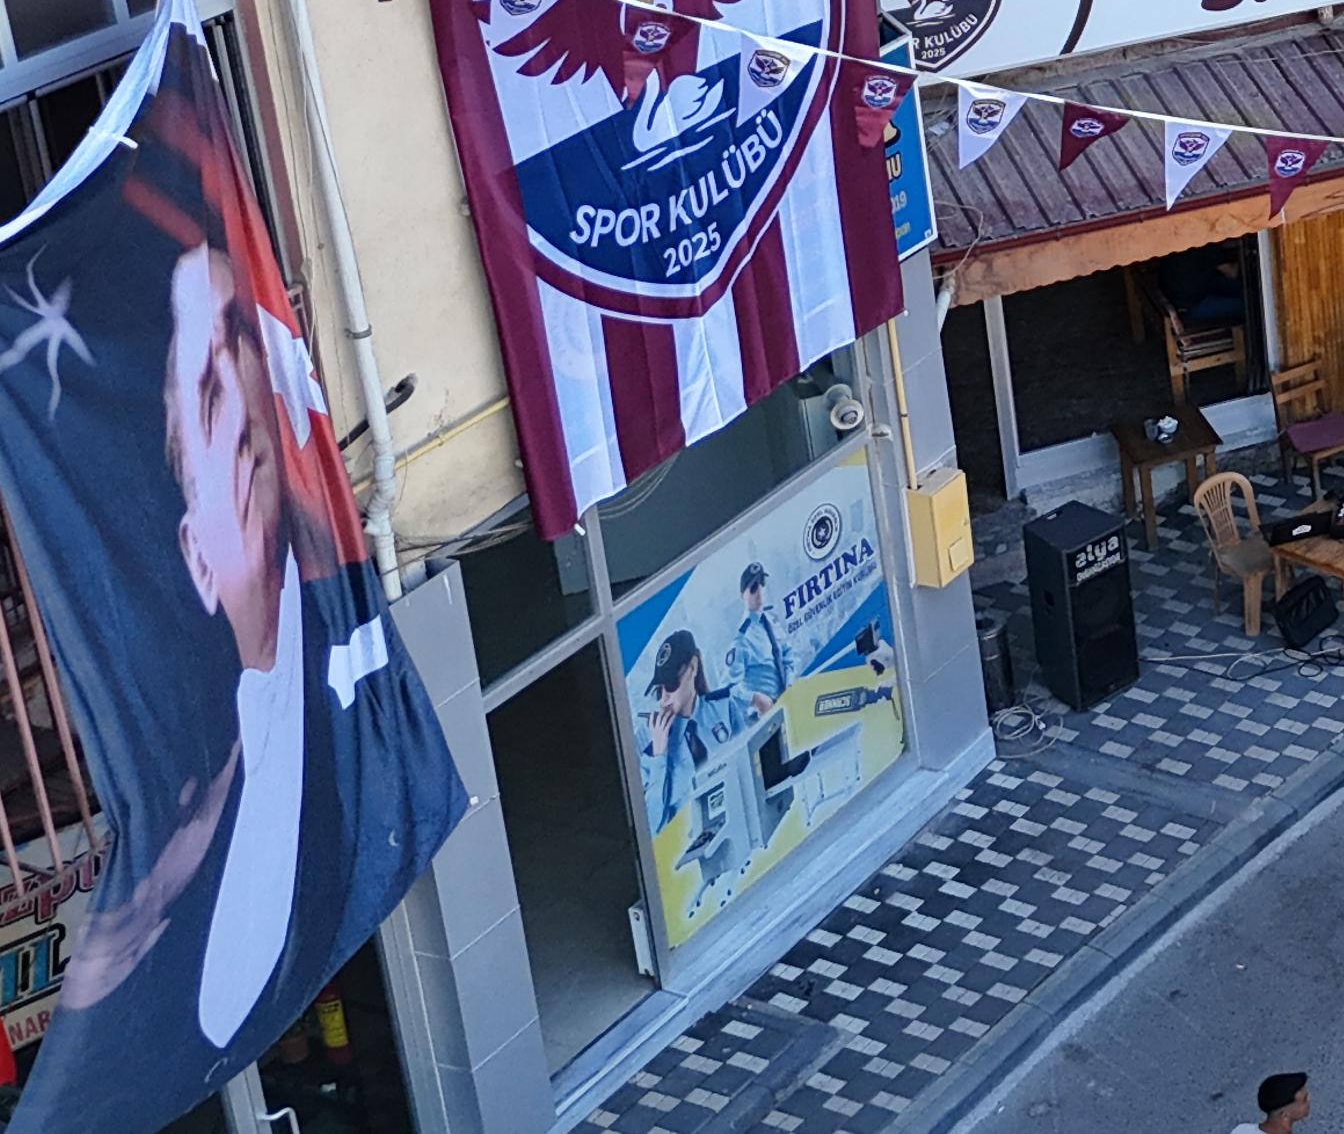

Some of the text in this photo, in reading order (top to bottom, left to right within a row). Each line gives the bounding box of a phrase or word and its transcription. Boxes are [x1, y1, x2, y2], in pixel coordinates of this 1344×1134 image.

[920, 47, 947, 60] 2025
[924, 14, 979, 49] KULÜBÜ
[569, 108, 784, 248] SPOR KULÜBÜ
[663, 222, 722, 279] 2025
[783, 537, 875, 620] FIRTINA
